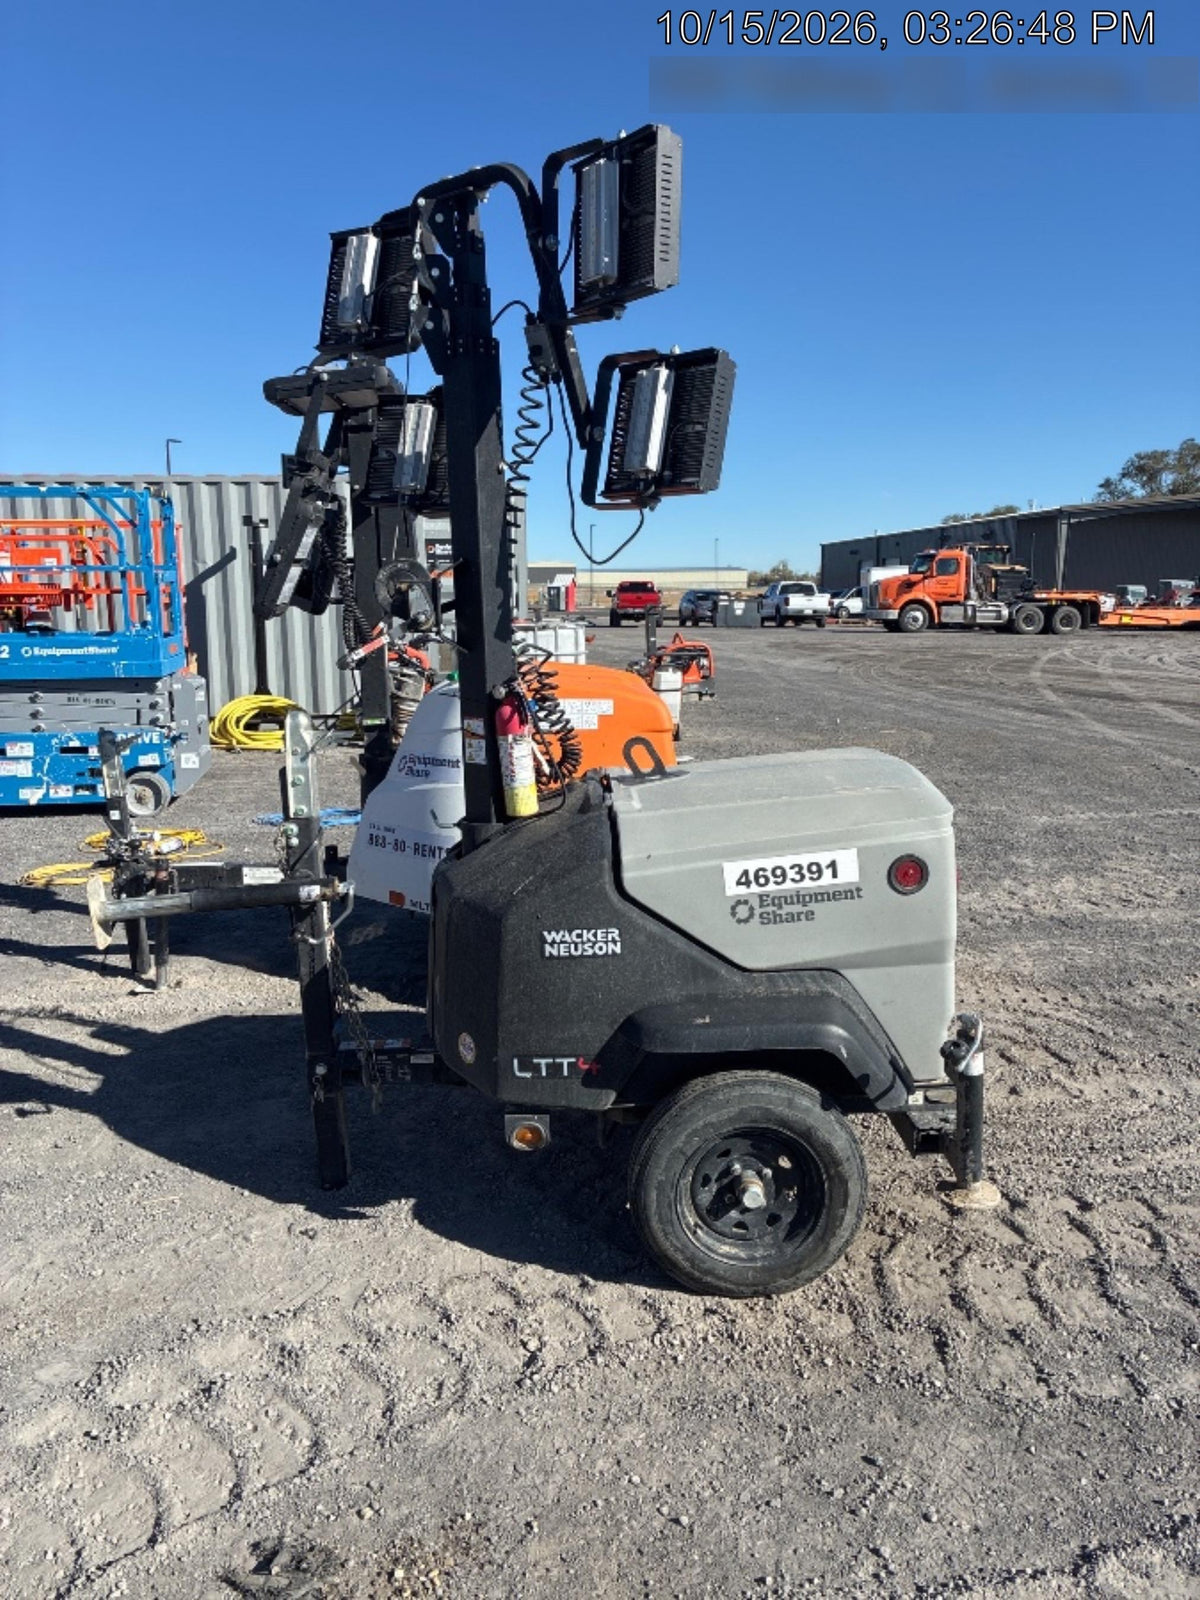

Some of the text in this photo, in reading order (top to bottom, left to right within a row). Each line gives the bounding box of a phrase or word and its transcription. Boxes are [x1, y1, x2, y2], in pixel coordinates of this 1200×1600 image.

[736, 859, 838, 889] 469391
[758, 887, 863, 910] Equipment
[759, 909, 815, 925] Share
[542, 928, 621, 943] WACKER
[545, 942, 621, 957] NEUSON
